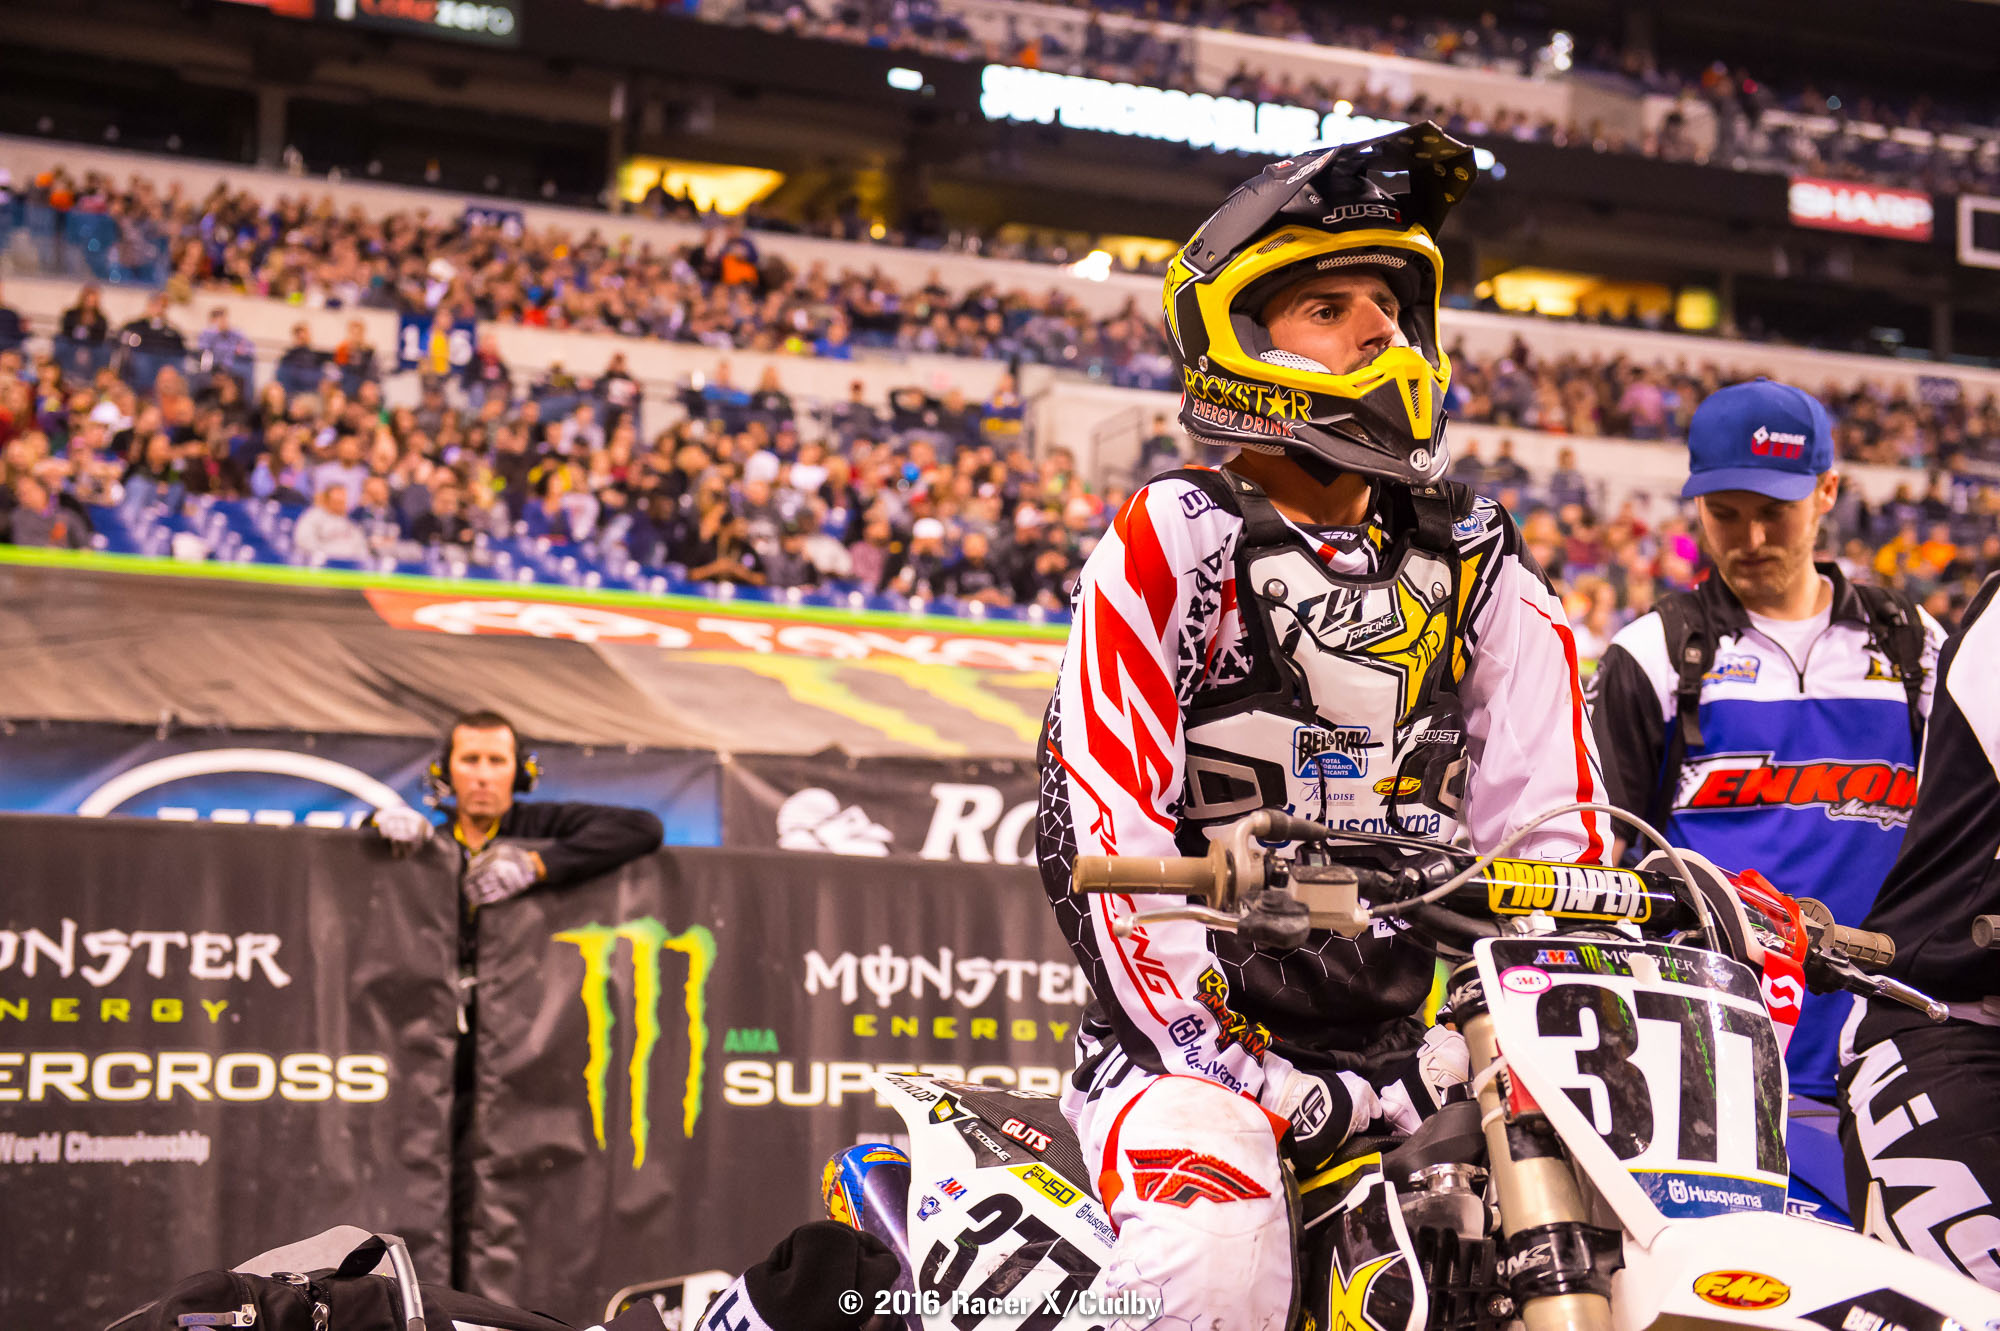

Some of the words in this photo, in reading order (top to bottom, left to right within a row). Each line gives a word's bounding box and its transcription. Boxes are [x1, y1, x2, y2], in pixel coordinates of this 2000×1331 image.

[1789, 182, 1934, 230] SHARP
[1193, 397, 1238, 426] ENERGY
[1241, 412, 1296, 438] DRINK
[1457, 516, 1477, 529] FIM
[1301, 781, 1355, 801] PAADISE
[1533, 949, 1580, 965] AMA
[723, 1028, 780, 1054] AMA
[853, 1013, 1071, 1042] ENERGY
[1536, 983, 1789, 1176] 377
[1002, 1118, 1052, 1152] GUTS
[935, 1177, 968, 1201] AMA
[1688, 1184, 1762, 1209] Husqvarna
[1083, 1211, 1117, 1243] Husqvarna
[1693, 1274, 1791, 1304] FMF
